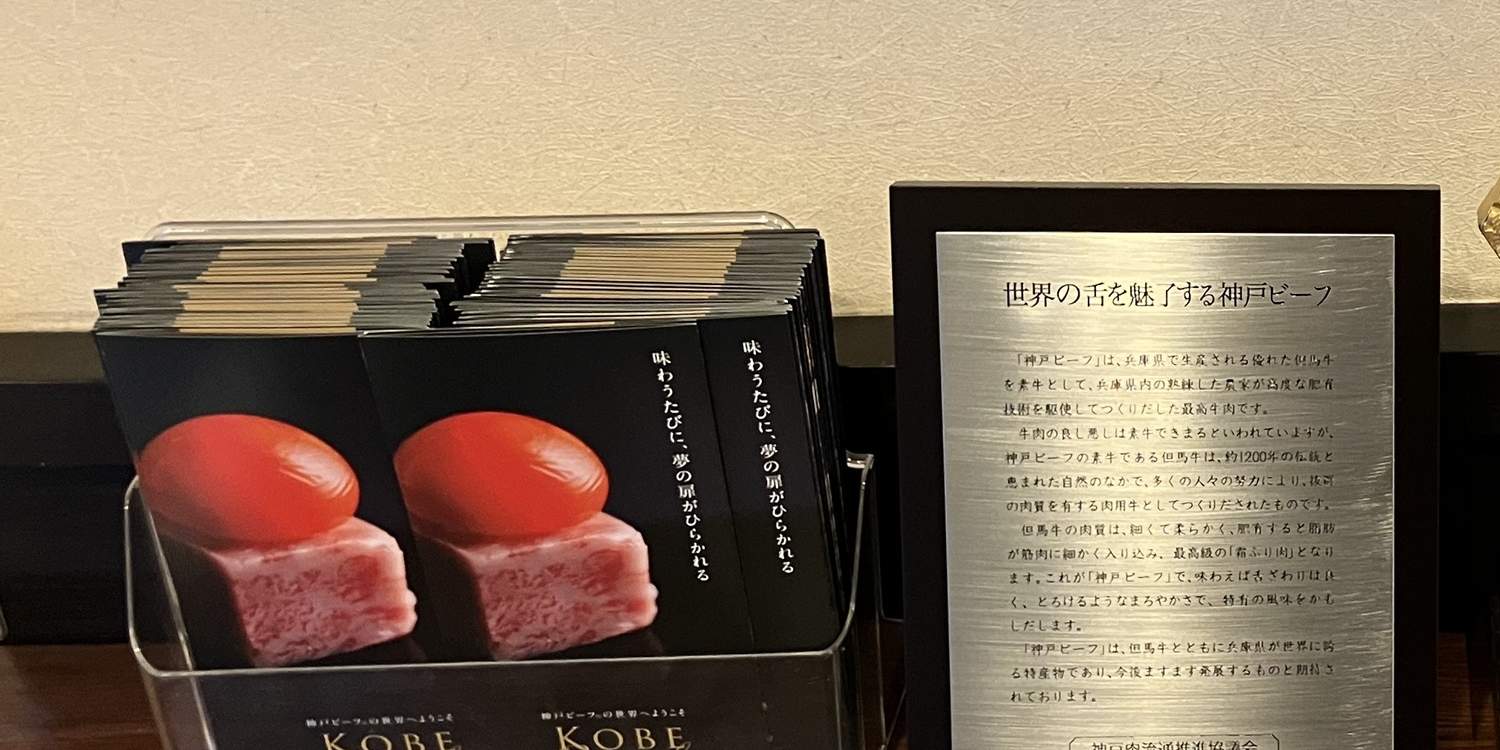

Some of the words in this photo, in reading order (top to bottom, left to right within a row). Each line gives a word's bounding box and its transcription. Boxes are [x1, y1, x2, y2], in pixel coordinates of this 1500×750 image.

[1003, 281, 1332, 308] 世界の舌を魅了する神戸ビーフ
[652, 350, 709, 582] 味わうたびに、夢の扉がひらかれる
[743, 339, 794, 574] 味わうたびに、夢の扉がひらかれる
[1010, 619, 1082, 633] しだします。
[1010, 688, 1097, 703] れております。
[322, 731, 454, 750] KOBE
[555, 726, 686, 750] KOBE
